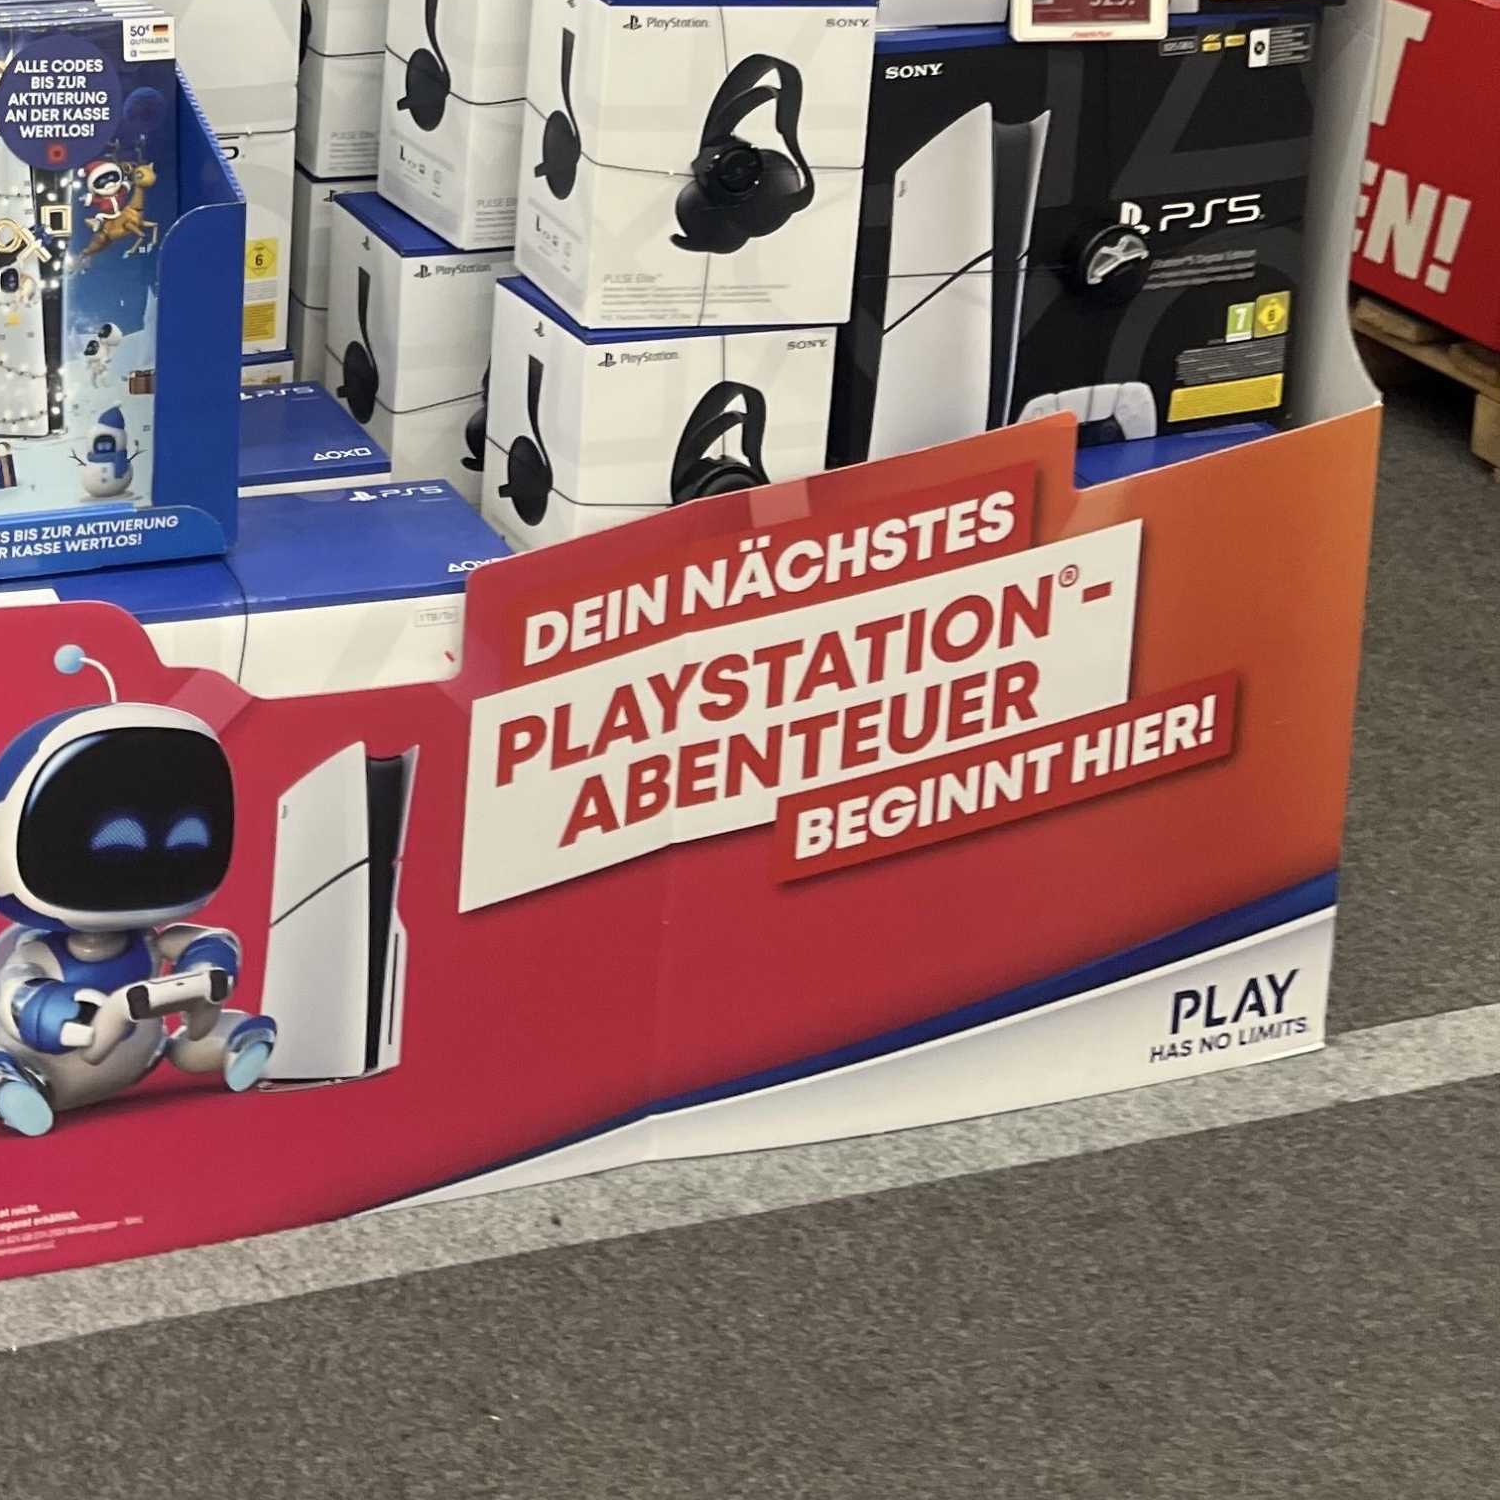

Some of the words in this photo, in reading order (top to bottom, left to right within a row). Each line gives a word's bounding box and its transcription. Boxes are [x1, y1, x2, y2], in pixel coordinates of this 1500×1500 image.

[130, 24, 150, 37] 50€
[646, 17, 710, 31] PlayStation
[825, 18, 870, 28] SONY
[129, 37, 169, 46] GUTHABEN
[14, 60, 48, 73] ALLE
[51, 59, 103, 73] CODES
[885, 62, 945, 80] SONY
[31, 76, 54, 89] BIS
[57, 75, 86, 89] ZUR
[8, 91, 108, 106] AKTIVIERUNG
[5, 110, 27, 123] AN
[31, 109, 60, 122] DER
[63, 107, 110, 121] KASSE
[19, 124, 95, 139] WERTLOS!
[1160, 194, 1261, 232] PS5
[255, 254, 264, 267] 6
[435, 264, 492, 276] PlayStation
[787, 338, 828, 351] SONY
[620, 350, 680, 365] PlayStation
[380, 486, 444, 498] PS5
[14, 528, 38, 542] BIS
[41, 525, 72, 540] ZUR
[75, 515, 179, 537] AKTIVIERUNG
[11, 542, 62, 558] KASSE
[65, 532, 142, 553] WERTLOS!
[523, 575, 669, 668] DEIN
[681, 491, 1016, 617] NÄCHSTES
[558, 660, 1040, 849] ABENTEUER
[795, 742, 1064, 861] BEGINNT
[1070, 695, 1219, 785] HIER!
[1170, 968, 1301, 1035] PLAY
[1150, 1040, 1194, 1064] HAS
[1199, 1032, 1232, 1054] NO
[1238, 1016, 1309, 1046] LIMITS
